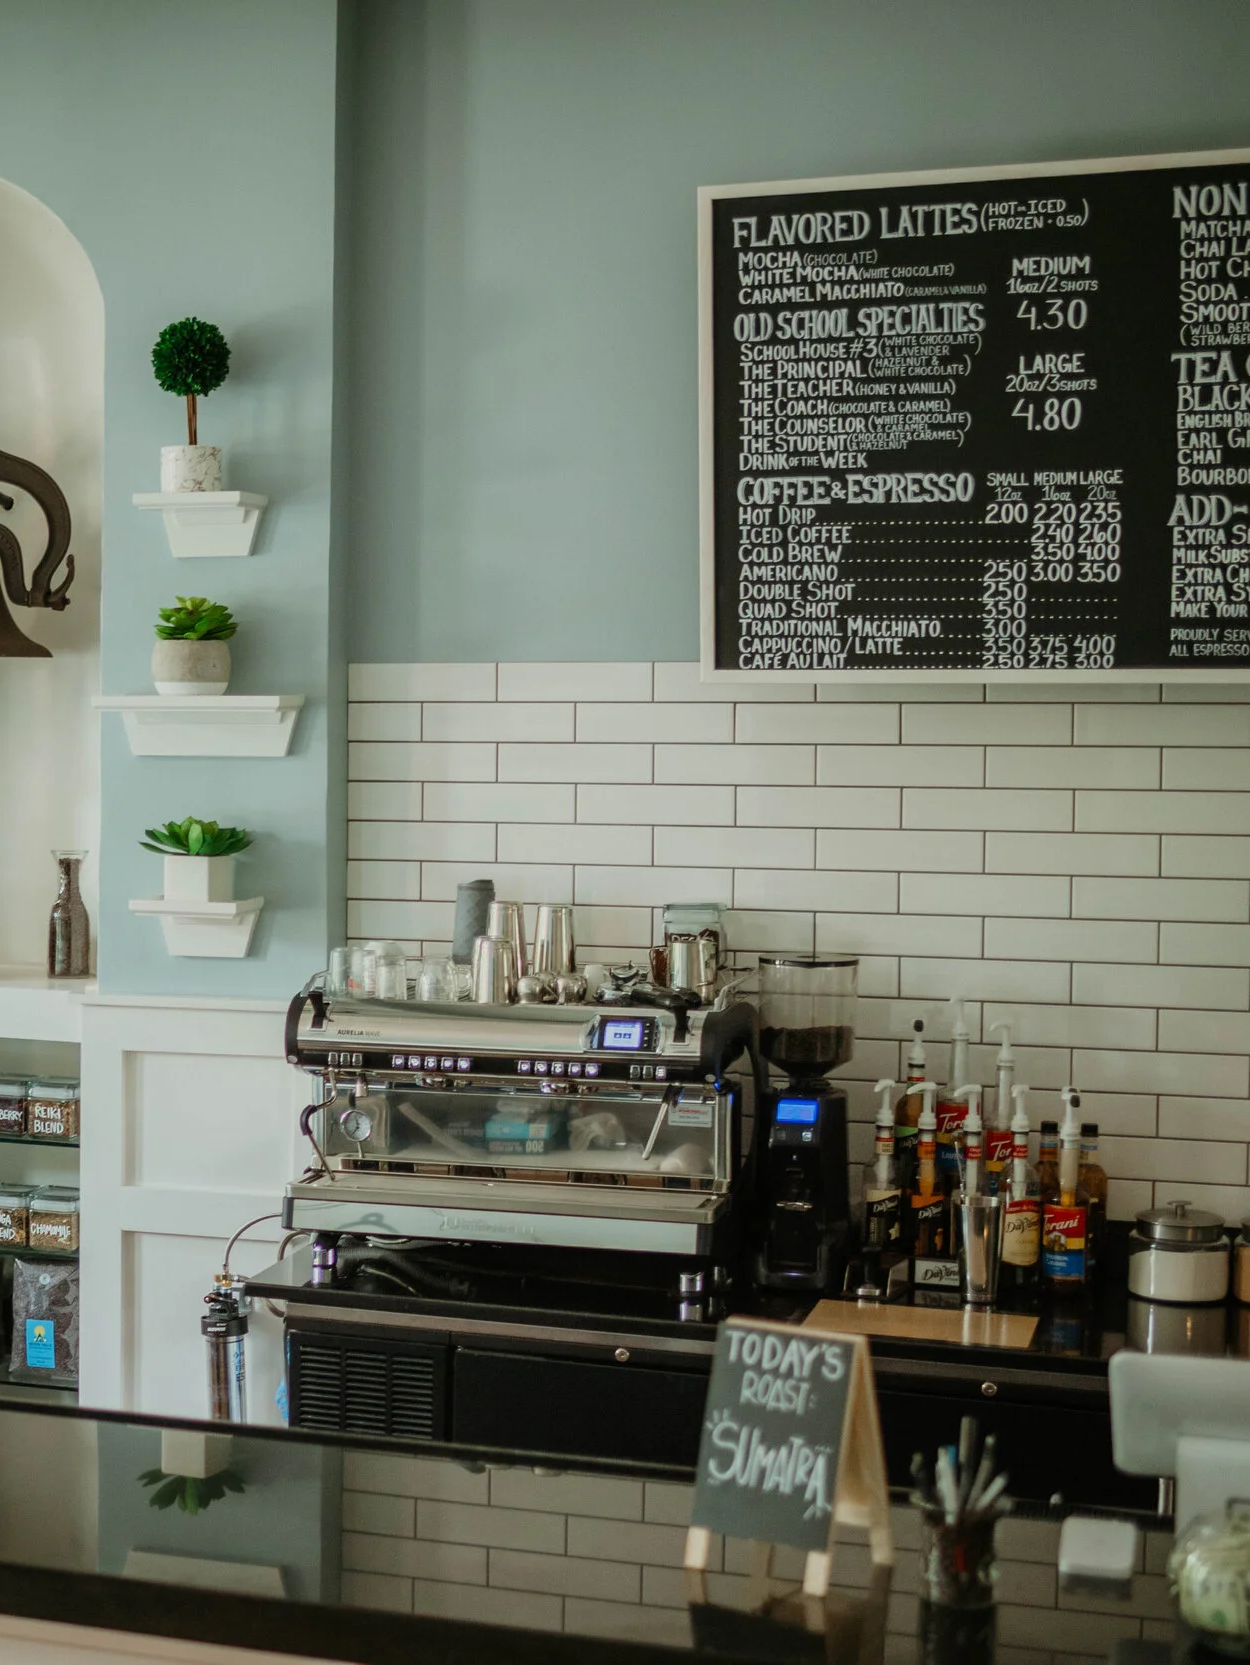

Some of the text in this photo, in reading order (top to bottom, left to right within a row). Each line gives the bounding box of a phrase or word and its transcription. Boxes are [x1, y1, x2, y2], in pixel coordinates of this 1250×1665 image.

[1027, 199, 1066, 214] ICED
[732, 203, 978, 248] FLAVORED LATTES
[988, 216, 1044, 231] FROZEN
[1180, 239, 1225, 258] CHAI
[738, 249, 878, 270] MOCHA (CHOCOLATE)
[1012, 256, 1090, 276] MEDIUM
[739, 268, 794, 286] WHITE
[796, 264, 858, 282] MOCHA
[892, 262, 955, 278] CHOCOLATE)
[1180, 260, 1220, 280] HOT
[738, 281, 904, 305] CARAMEL MACCHIATO
[1178, 281, 1238, 302] SODA
[734, 302, 986, 342] OLD SCHOOL SPECIALTIES
[1016, 299, 1088, 330] 4.30
[849, 338, 878, 360] #3
[739, 362, 774, 380] THE
[777, 359, 867, 380] PRINCIPAL
[931, 356, 939, 366] &
[874, 367, 906, 378] WHITE
[1019, 353, 1086, 375] LARGE
[1170, 350, 1238, 384] TEA
[739, 380, 773, 398] THE
[774, 379, 854, 398] TEACHER
[739, 399, 774, 417] THE
[774, 398, 828, 416] COACH
[1011, 398, 1082, 431] 4.80
[739, 418, 774, 436] THE
[775, 416, 866, 435] COUNSELOR
[1177, 412, 1232, 430] ENGLISH
[739, 435, 774, 454] THE
[775, 434, 848, 453] STUDENT
[1177, 430, 1223, 450] EARL
[739, 452, 868, 470] DRINK OF THE WEEK
[1177, 449, 1222, 465] CHAI
[986, 470, 1124, 486] SMALL MEDIUM LARGE
[737, 472, 975, 505] COFFEE & ESPRESSO
[994, 485, 1118, 501] 12oz 16oz 20oz
[738, 507, 772, 525] HOT
[778, 505, 816, 525] DRIP
[984, 503, 1028, 524] 2.00
[739, 523, 1122, 544] ICED COFFEE 2.40 2.60
[1172, 526, 1226, 546] EXTRA
[738, 543, 1120, 564] COLD BREW 3.50 4.00
[1172, 548, 1208, 564] MILK
[739, 564, 838, 582] AMERICANO
[1030, 562, 1074, 582] 3.00
[1172, 565, 1223, 584] EXTRA
[739, 582, 802, 600] DOUBLE
[807, 582, 856, 600] SHOT
[1171, 582, 1226, 602] EXTRA
[738, 600, 1026, 619] QUAD SHOT 3.50
[1170, 601, 1248, 618] MAKE YOUR
[738, 618, 1026, 638] TRADITIONAL MACCHIATO 3.00
[1170, 628, 1218, 642] PROUDLY
[982, 638, 1026, 655] 3.50
[1028, 637, 1068, 655] 3.75
[1073, 636, 1116, 655] 4.00
[1168, 644, 1189, 656] ALL
[786, 653, 811, 669] AU
[812, 654, 847, 669] LAIT
[982, 654, 1024, 668] 2.50
[1028, 654, 1068, 668] 2.75
[1074, 654, 1114, 668] 3.00
[34, 1120, 64, 1134] BLEND
[724, 1329, 845, 1382] TODAY'S
[708, 1420, 827, 1508] SUMATRA
